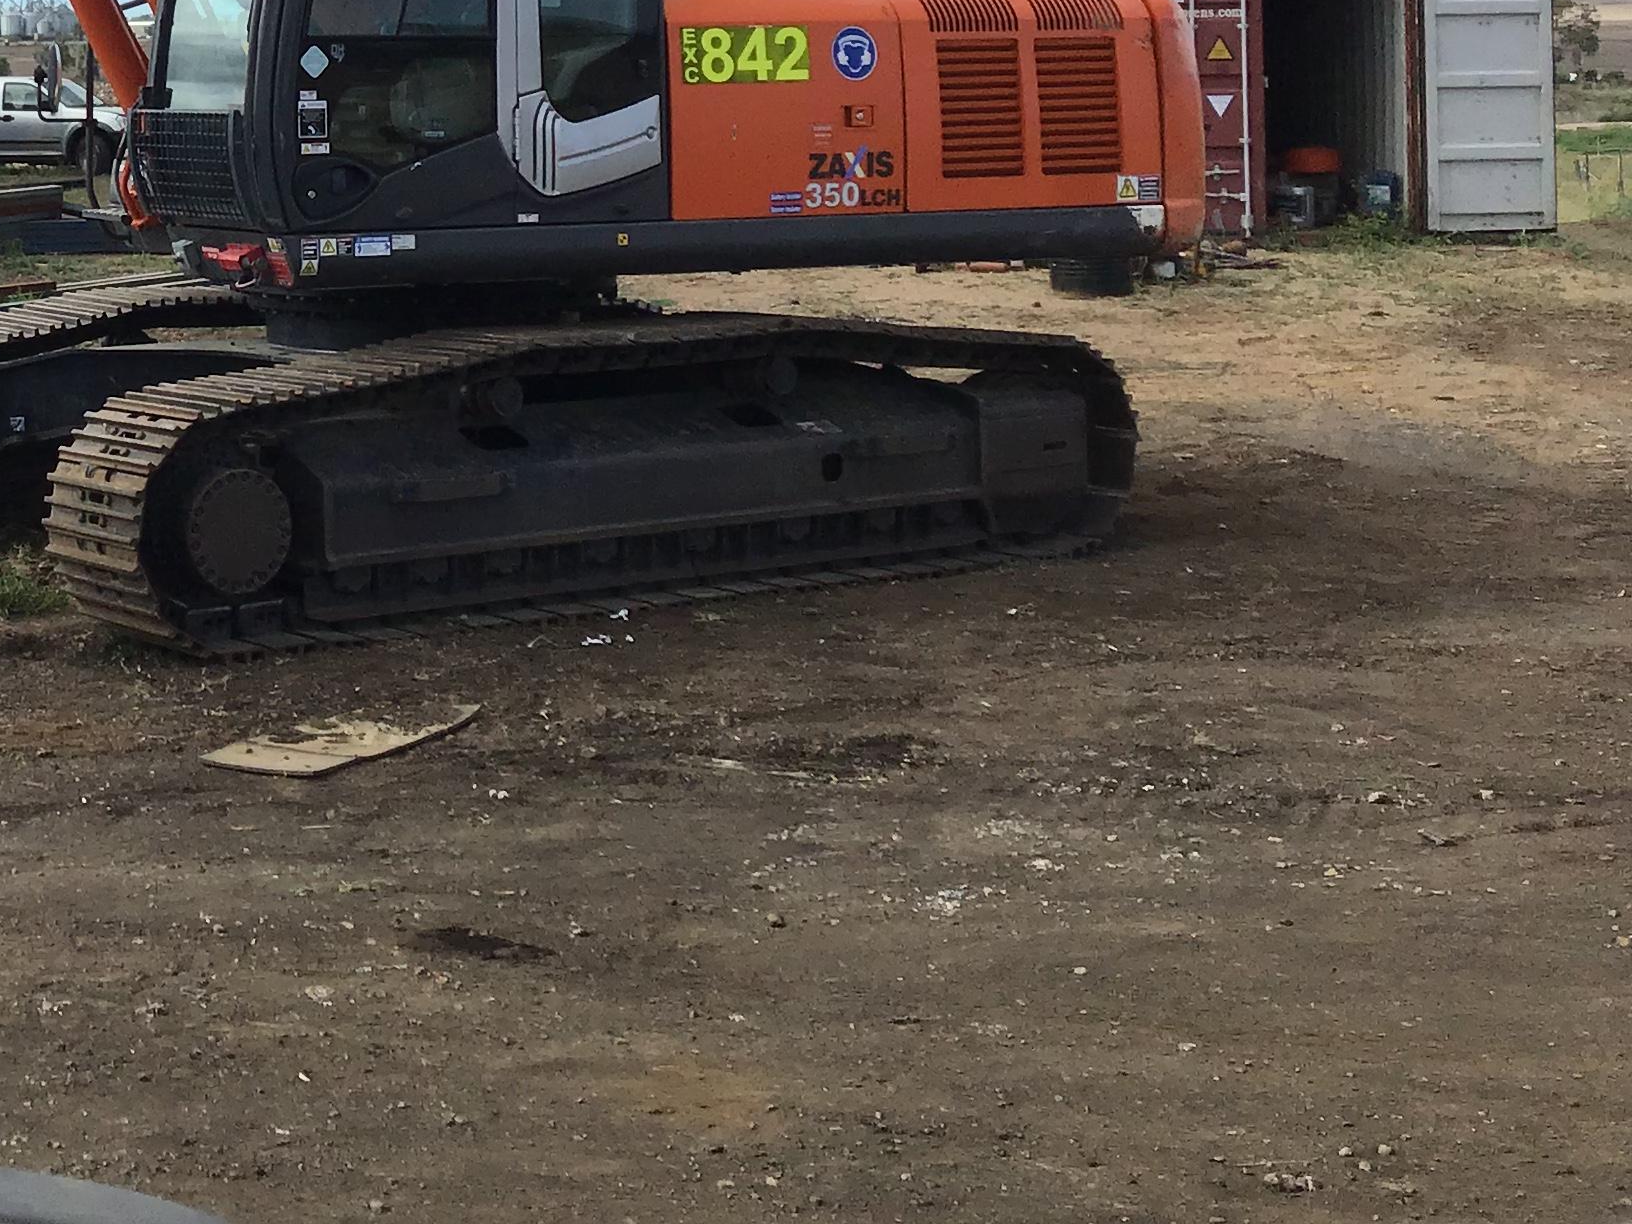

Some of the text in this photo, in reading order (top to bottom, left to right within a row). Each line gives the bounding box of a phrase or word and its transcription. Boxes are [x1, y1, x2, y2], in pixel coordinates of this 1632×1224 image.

[682, 26, 809, 83] EXC 842
[808, 145, 895, 180] ZAXIS
